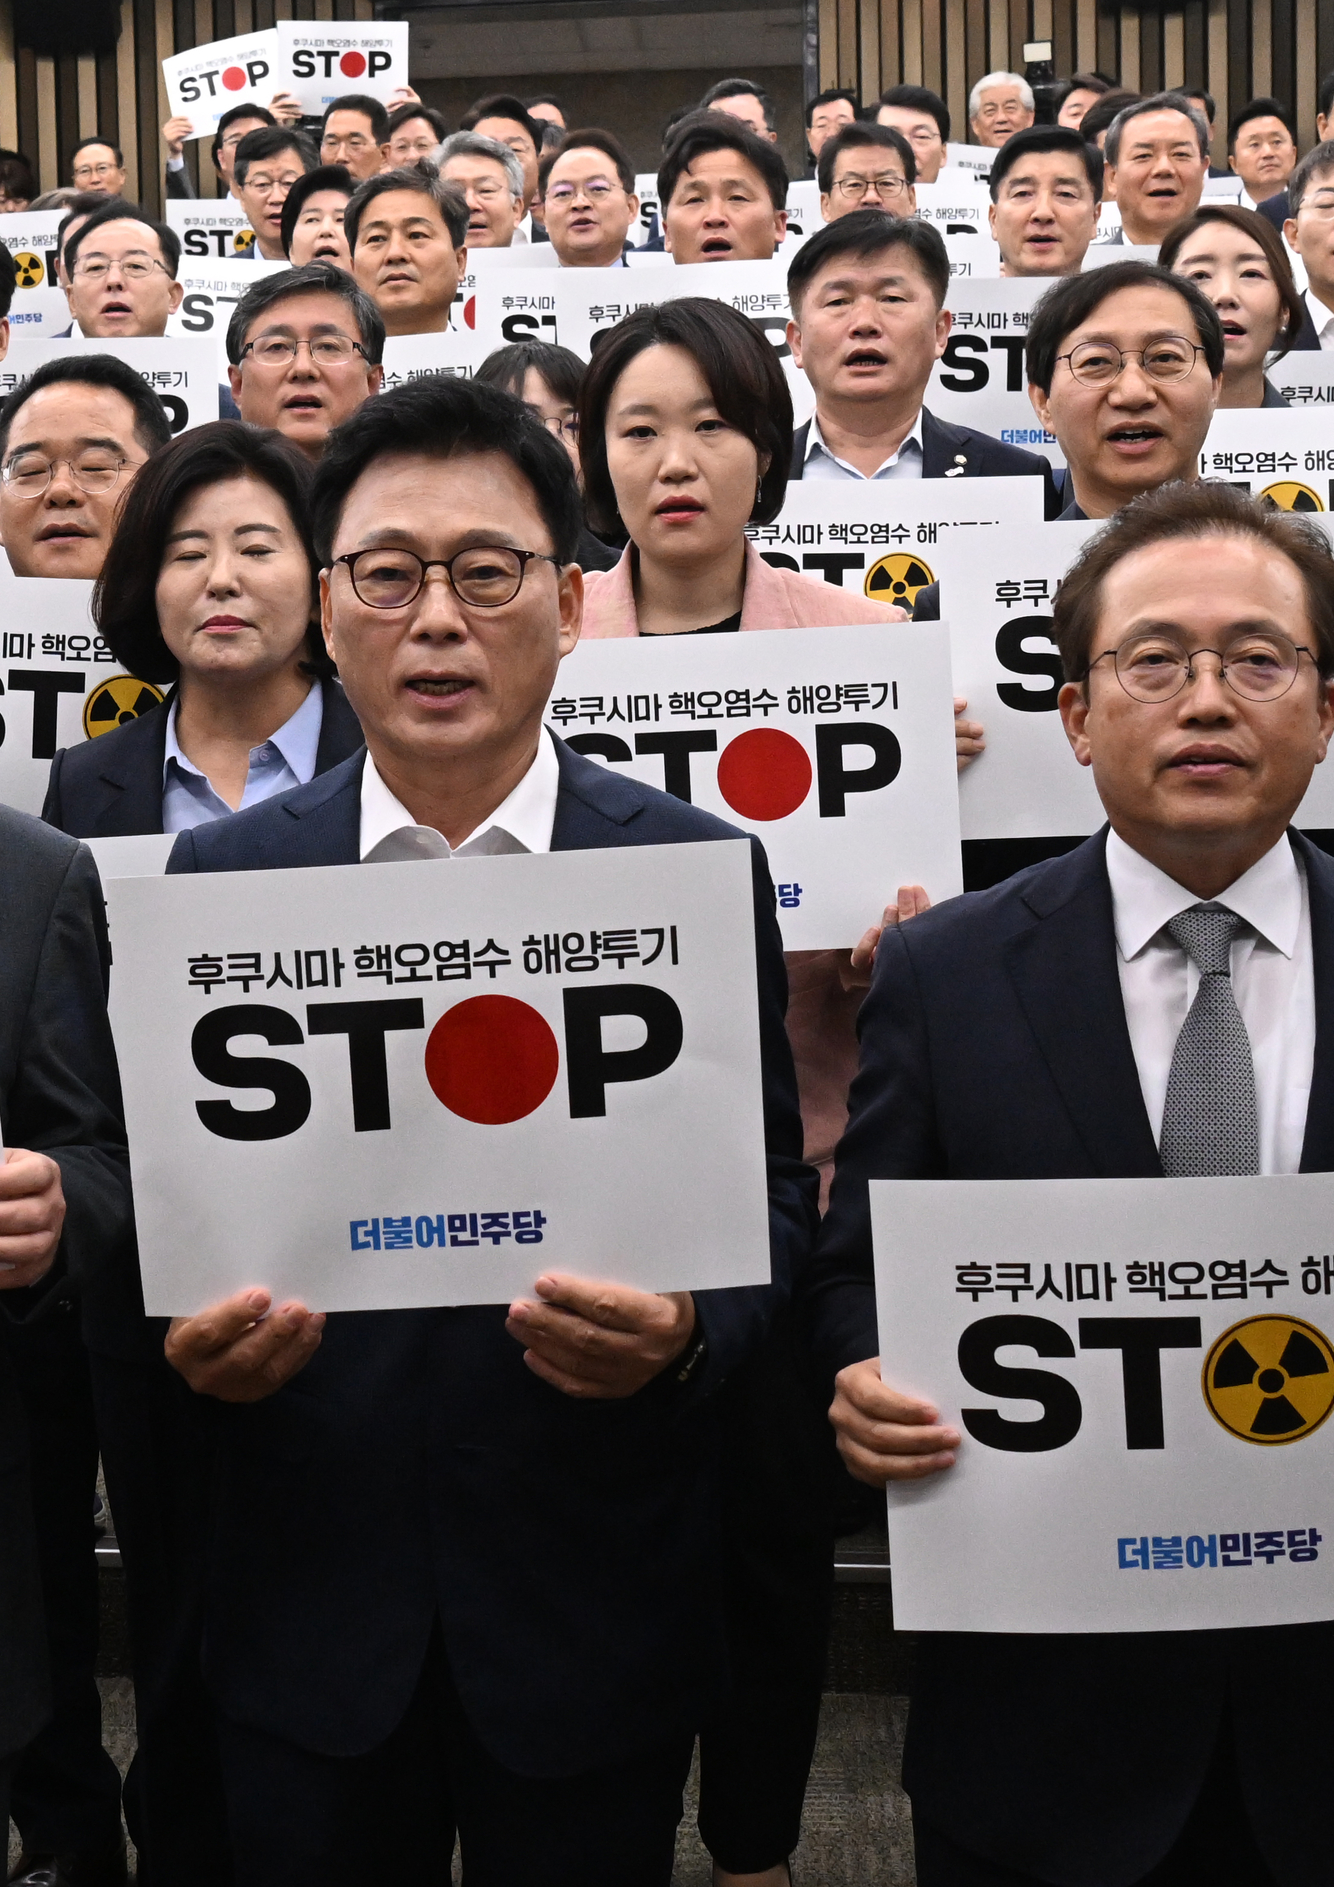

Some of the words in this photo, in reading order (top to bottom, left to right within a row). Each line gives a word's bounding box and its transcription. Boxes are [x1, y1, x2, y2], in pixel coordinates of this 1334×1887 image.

[1213, 452, 1297, 473] 핵오염수
[828, 523, 911, 544] 핵오염수
[550, 694, 662, 727] 후쿠시마
[668, 687, 779, 720] 핵오염수
[787, 681, 898, 714] 해양투기
[187, 947, 344, 995] 후쿠시마
[353, 939, 511, 985] 핵오염수
[522, 925, 679, 974] 해양투기
[349, 1210, 546, 1251] 더불어민주당
[955, 1261, 1117, 1303] 후쿠시마
[1125, 1259, 1290, 1302] 핵오염수
[1117, 1528, 1322, 1571] 더불어민주당
